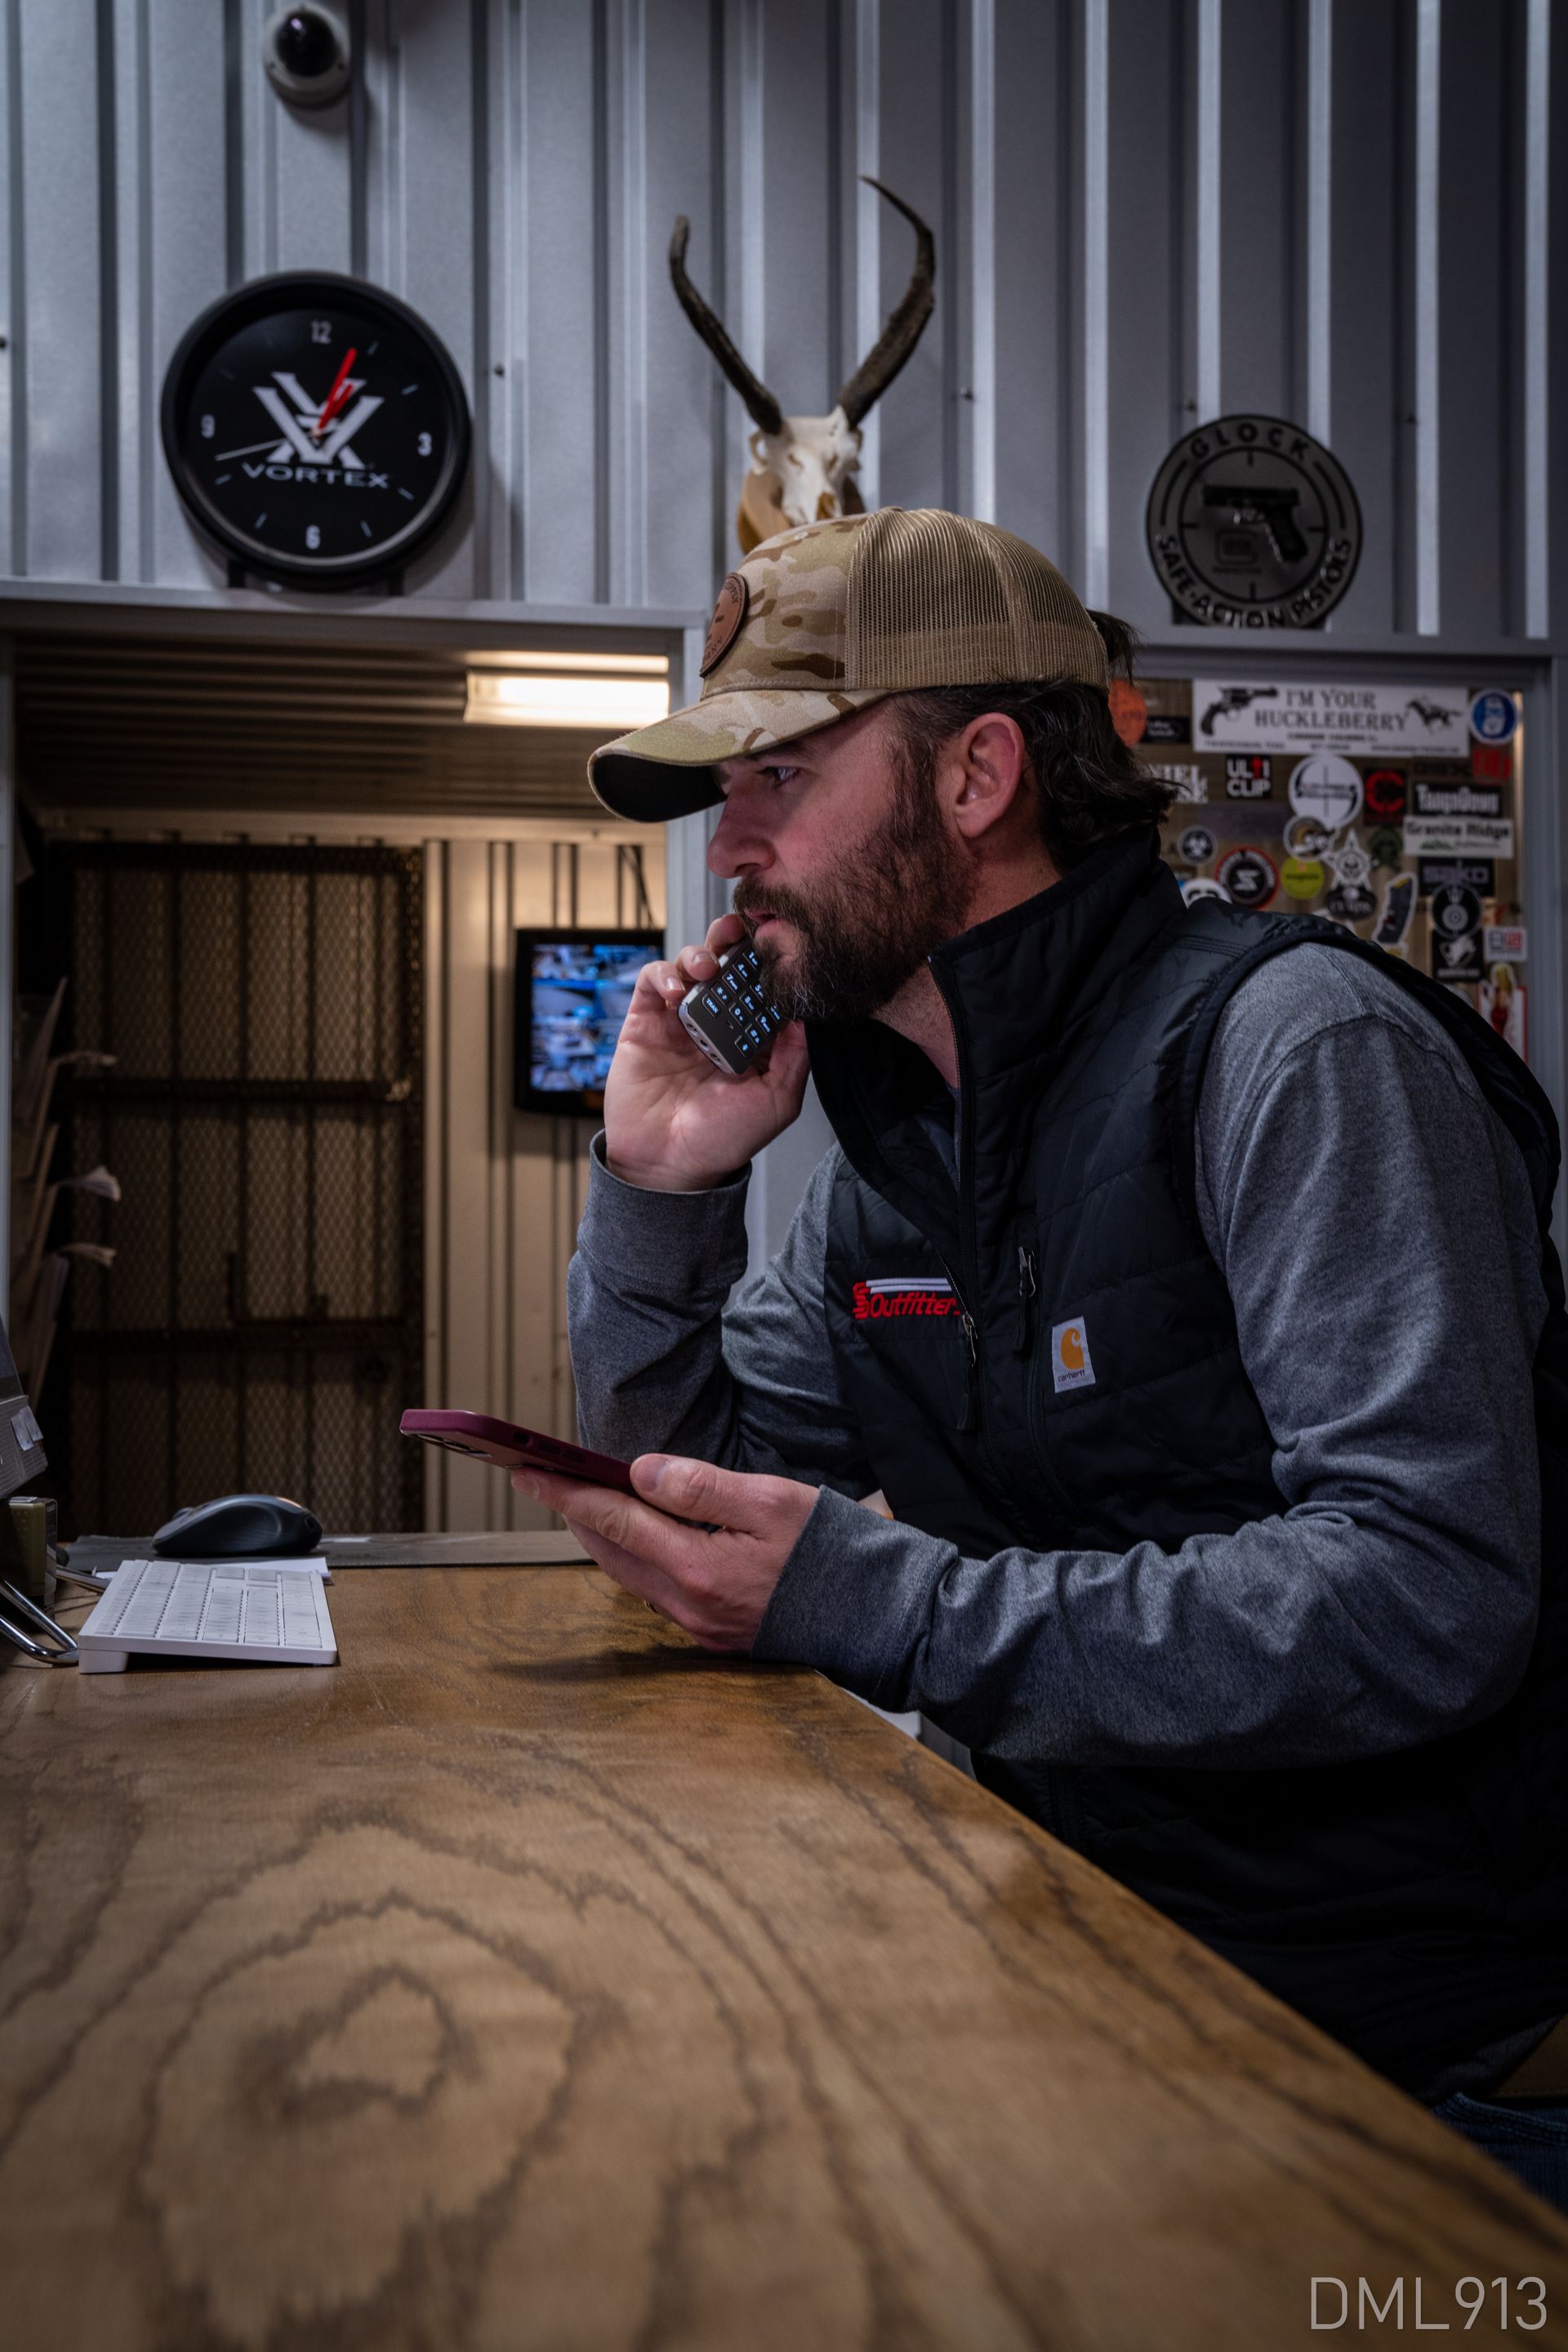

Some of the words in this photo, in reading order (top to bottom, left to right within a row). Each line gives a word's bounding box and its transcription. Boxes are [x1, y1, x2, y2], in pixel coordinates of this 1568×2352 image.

[310, 321, 332, 344] 12
[201, 414, 216, 439] 9
[417, 432, 432, 457] 3
[1191, 421, 1309, 460] GLOCK
[242, 462, 390, 489] VORTEX
[305, 524, 320, 550] 6
[1291, 538, 1352, 617] PISTOLS
[1286, 689, 1315, 706] I'M
[1321, 691, 1377, 709] YOUR
[1254, 710, 1407, 731] HUCKLEBERRY
[1227, 779, 1271, 798] CLIP
[1406, 822, 1461, 835] Granite
[1465, 824, 1508, 840] Ridge
[1058, 1370, 1085, 1383] carhartt
